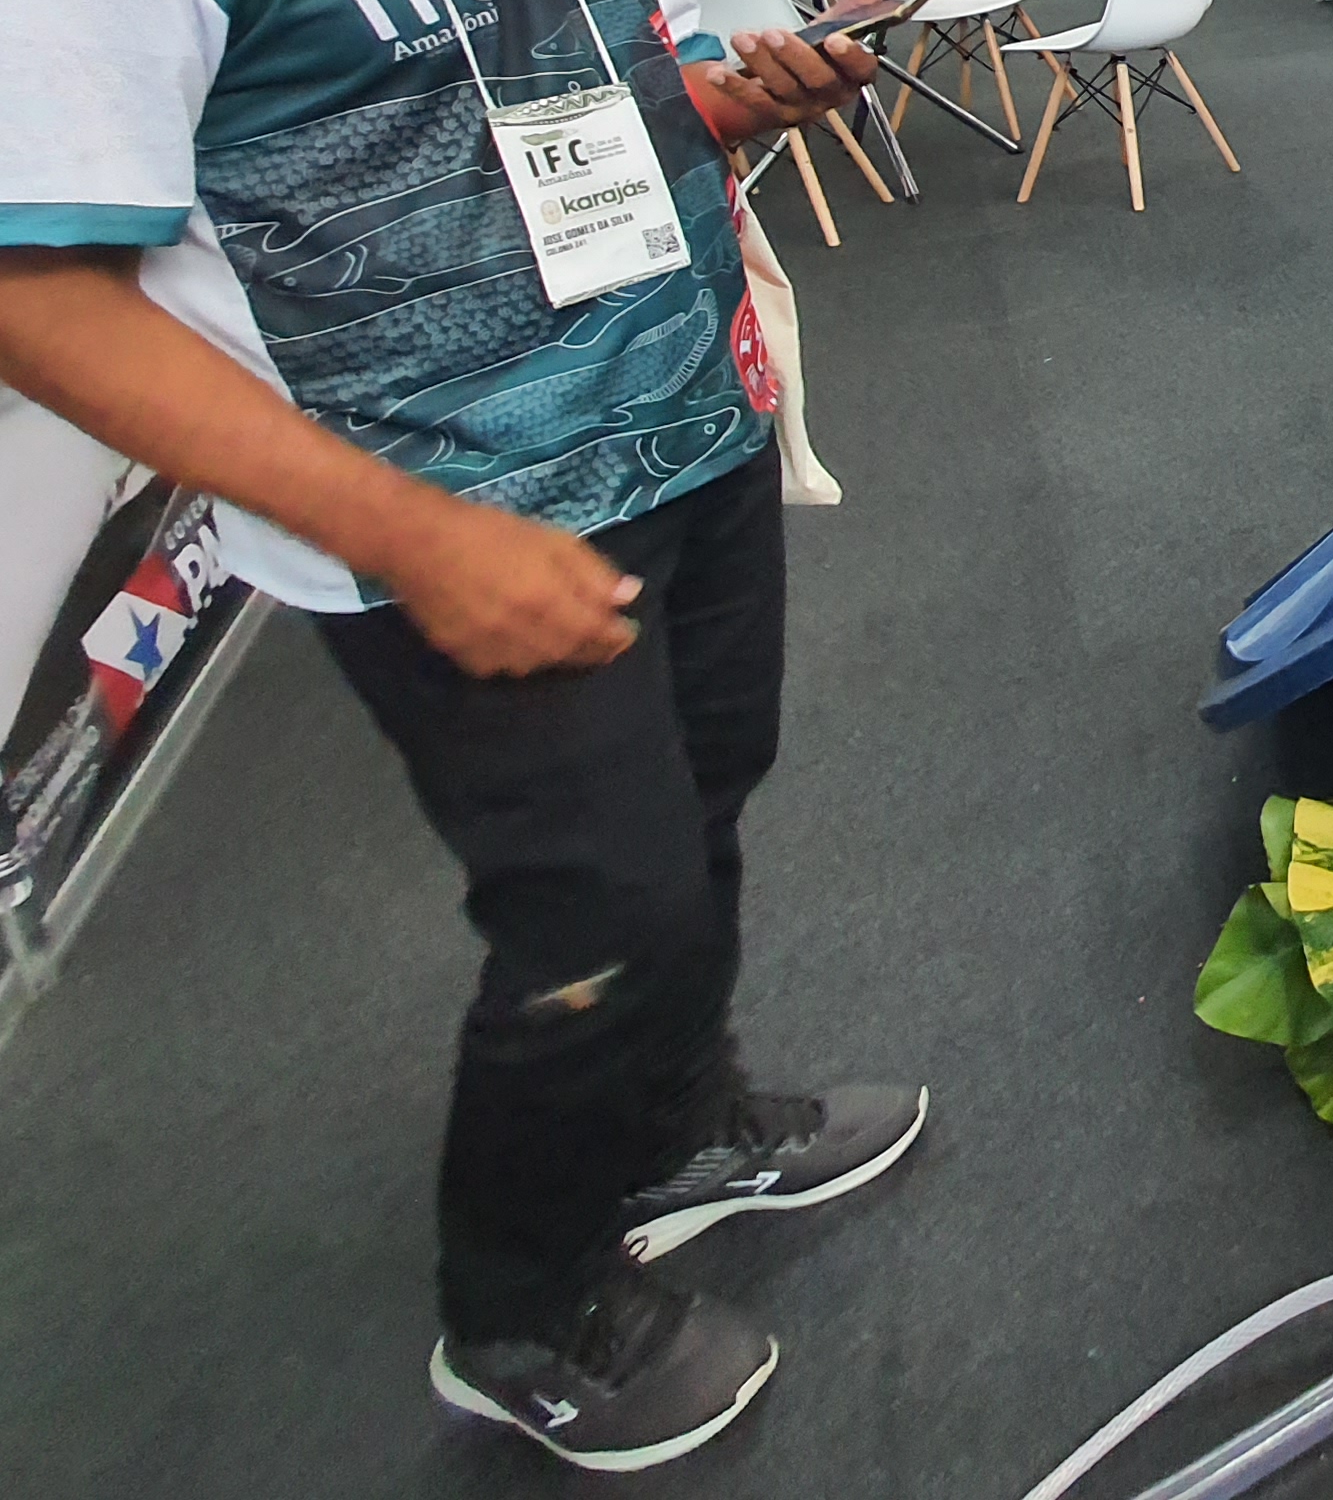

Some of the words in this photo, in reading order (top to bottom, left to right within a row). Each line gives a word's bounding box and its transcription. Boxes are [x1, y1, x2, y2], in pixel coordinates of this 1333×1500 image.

[525, 139, 589, 178] IFC
[537, 168, 592, 188] Amazônia
[560, 179, 650, 216] karajás
[564, 222, 596, 240] GOMES
[599, 217, 609, 231] DA
[611, 212, 635, 227] SILVA
